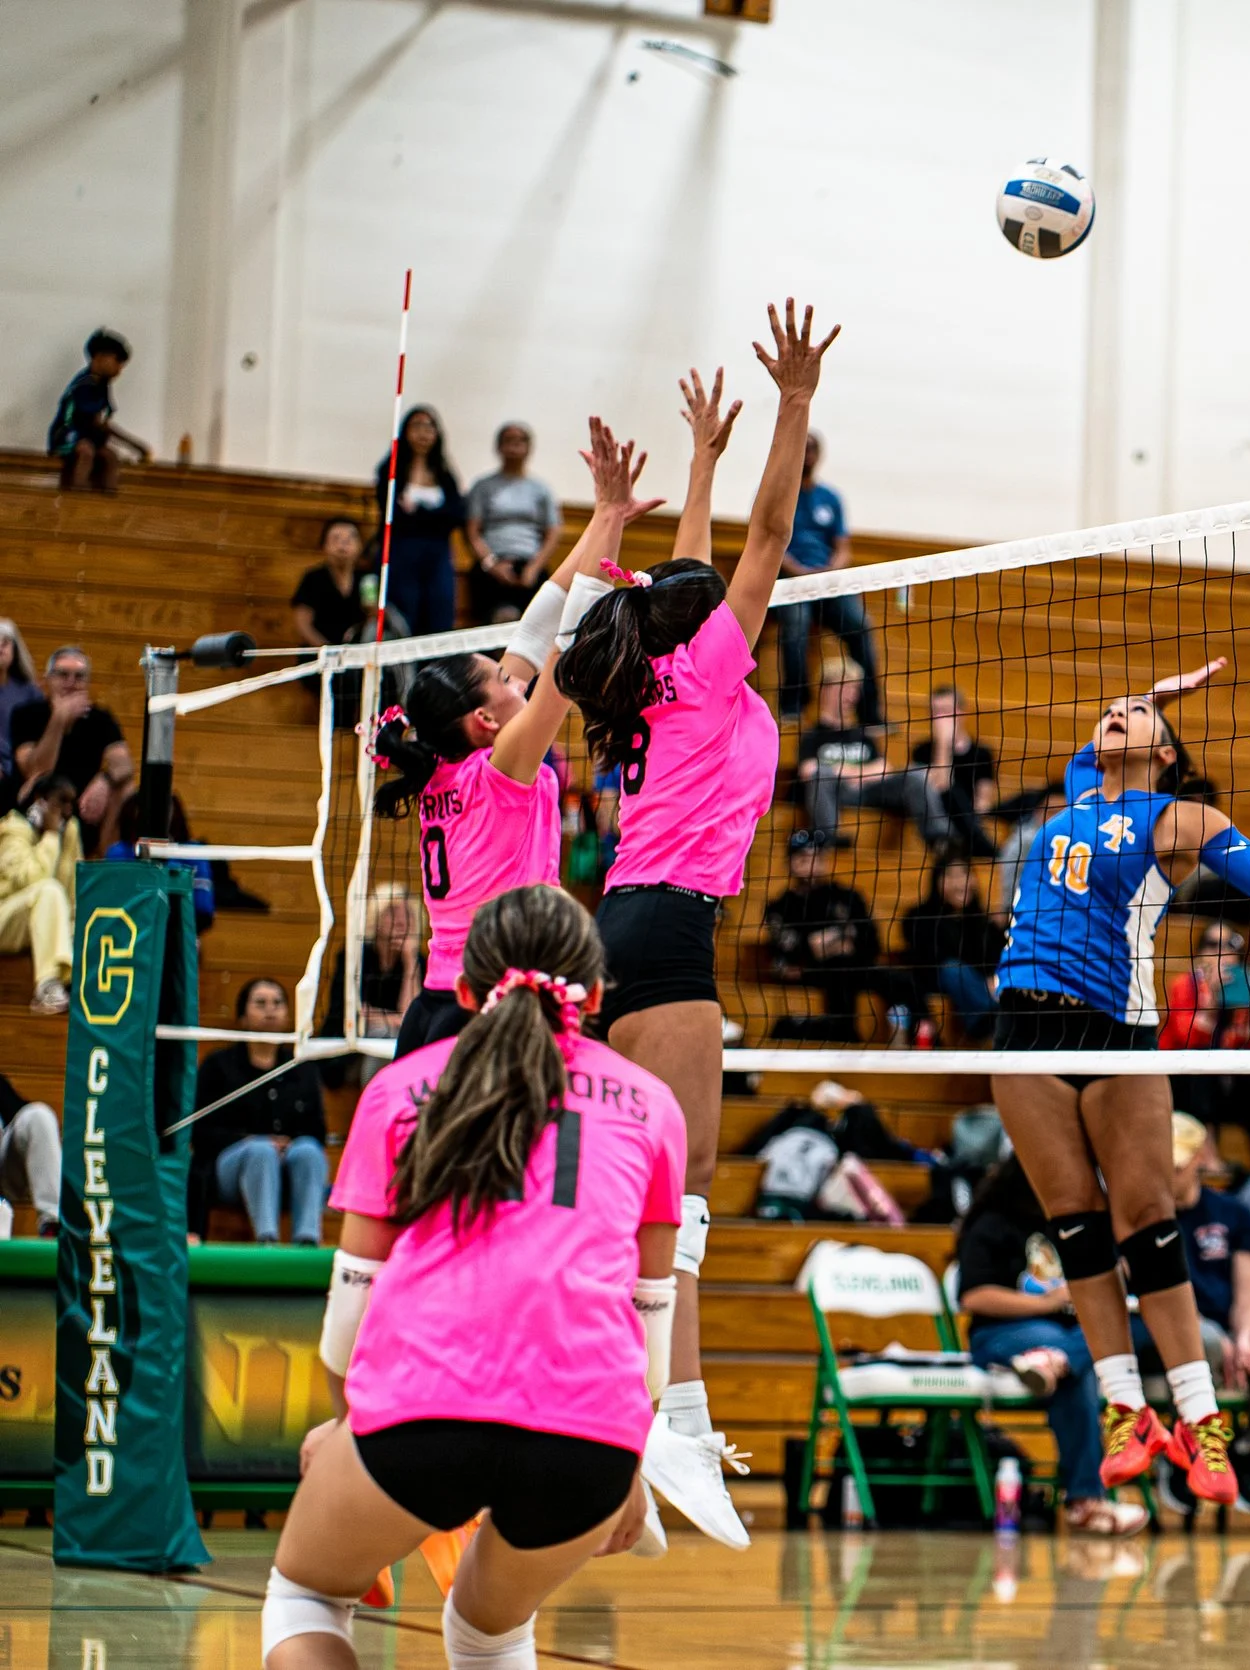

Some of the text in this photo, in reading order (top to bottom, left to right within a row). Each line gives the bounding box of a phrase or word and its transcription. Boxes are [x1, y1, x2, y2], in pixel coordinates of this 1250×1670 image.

[1048, 834, 1093, 896] 10
[79, 907, 137, 1025] C
[83, 1046, 120, 1496] CLEVELAND
